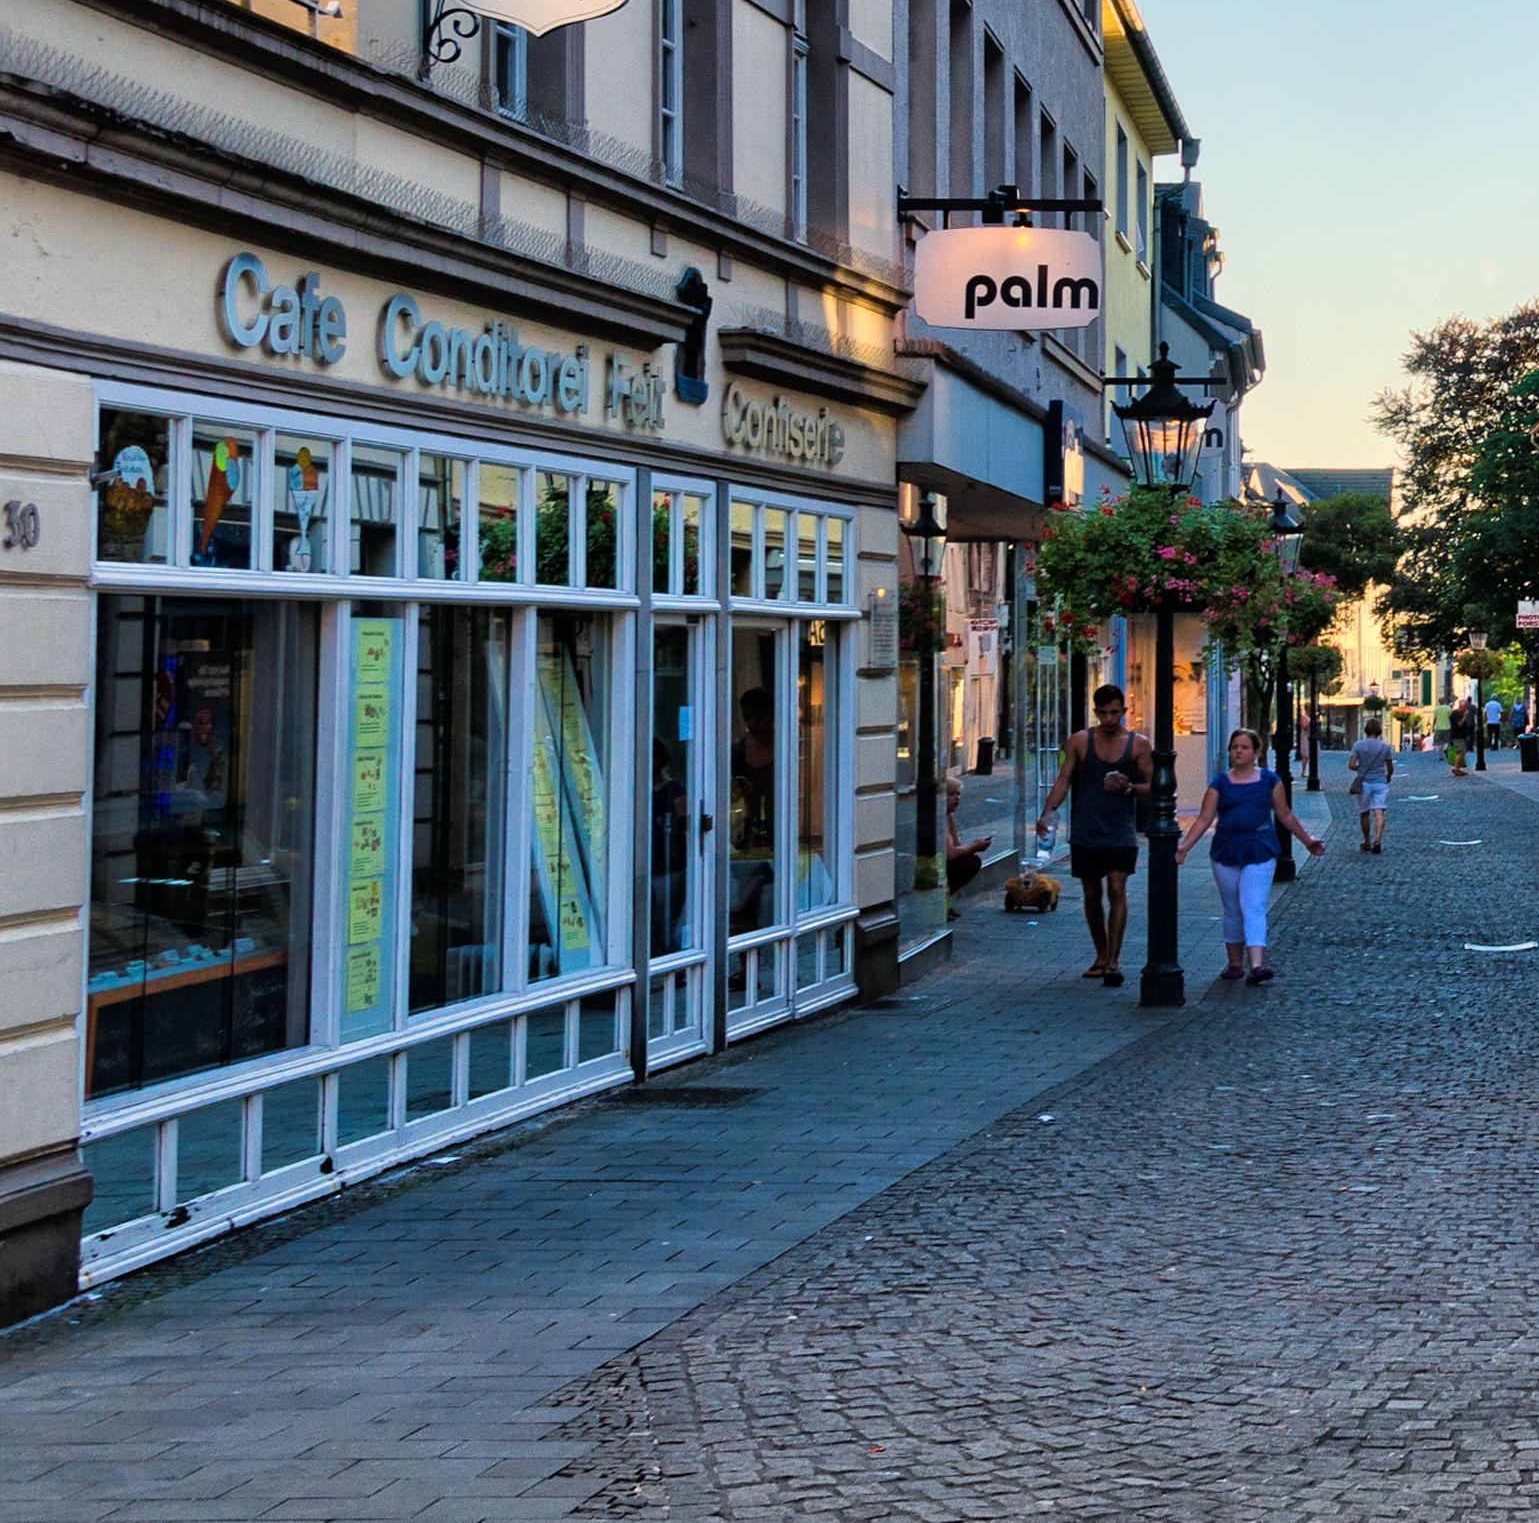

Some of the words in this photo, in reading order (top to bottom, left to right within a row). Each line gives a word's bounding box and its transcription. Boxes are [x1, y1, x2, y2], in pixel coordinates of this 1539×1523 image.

[965, 264, 1099, 319] palm
[222, 251, 347, 365] Cafe
[383, 291, 590, 415] Conditorei
[610, 350, 666, 429] Feit
[725, 380, 846, 466] Confiserie
[4, 500, 41, 548] 30
